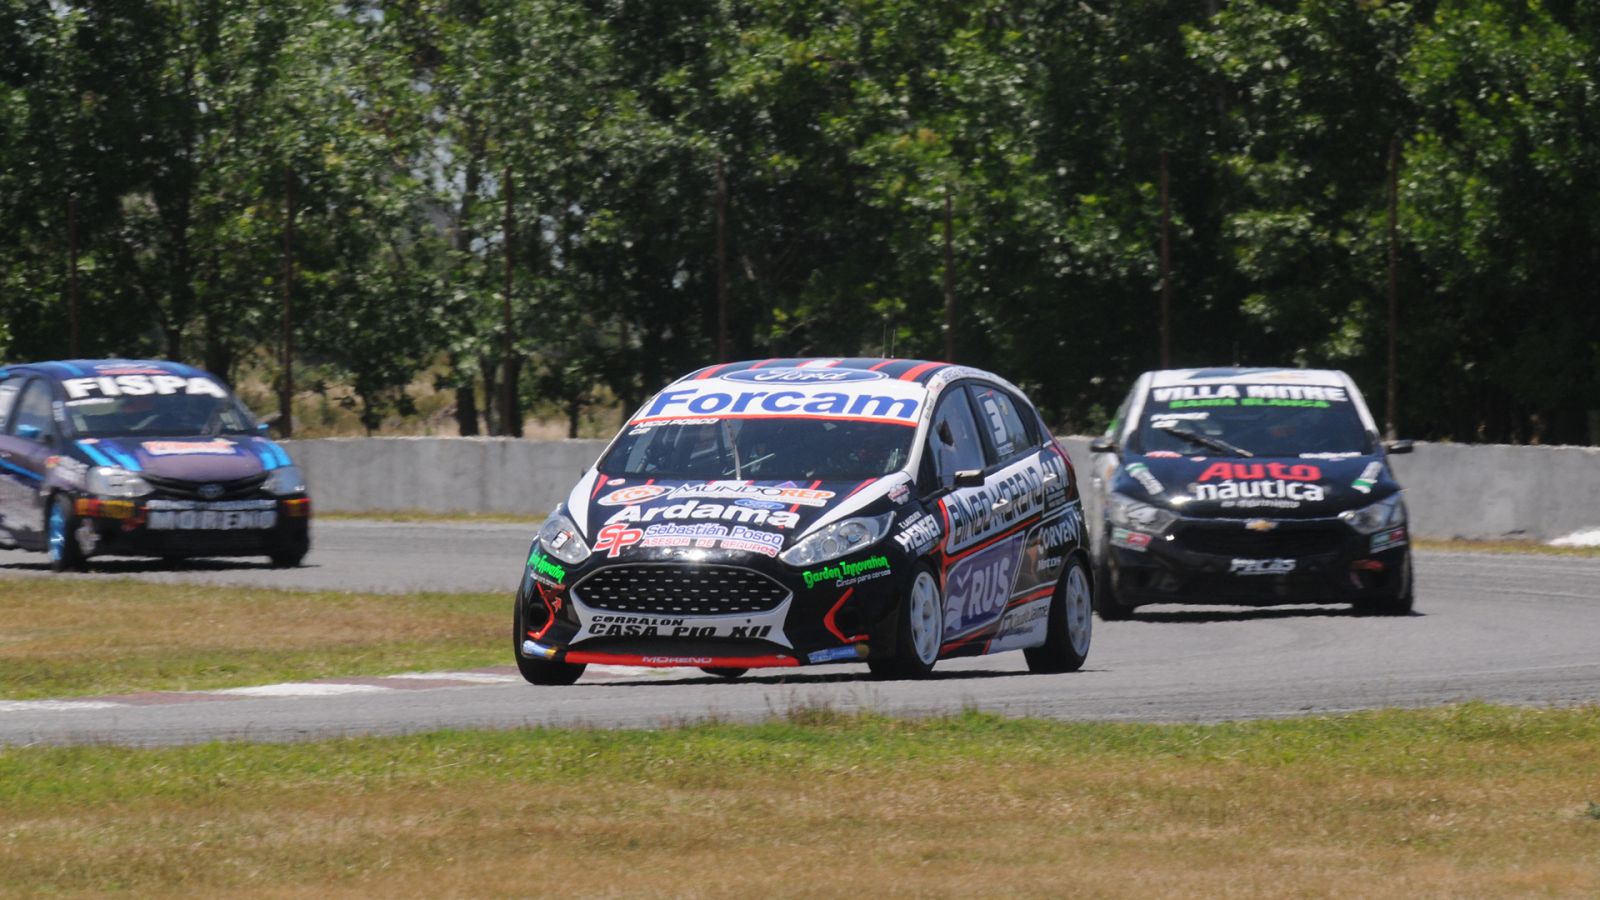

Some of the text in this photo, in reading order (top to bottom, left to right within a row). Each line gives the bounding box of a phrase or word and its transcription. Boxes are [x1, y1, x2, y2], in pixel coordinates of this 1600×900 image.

[757, 369, 849, 382] Ford
[61, 375, 228, 399] FISPA
[1153, 385, 1348, 401] VILLA MITRE
[645, 388, 919, 419] Forcam
[983, 399, 1008, 446] 3
[1197, 462, 1322, 482] Auto
[675, 484, 832, 500] MUNDOREP
[1196, 479, 1324, 502] náutica
[605, 500, 800, 528] Ardama
[592, 524, 643, 557] SP
[646, 523, 784, 545] Sebastián Posco
[642, 538, 779, 557] ASESOR DE SEGUROS
[802, 556, 890, 589] Garden Innovation
[968, 557, 1010, 619] RUS
[588, 623, 773, 638] CASA PIO XII
[642, 655, 713, 664] MORENO
